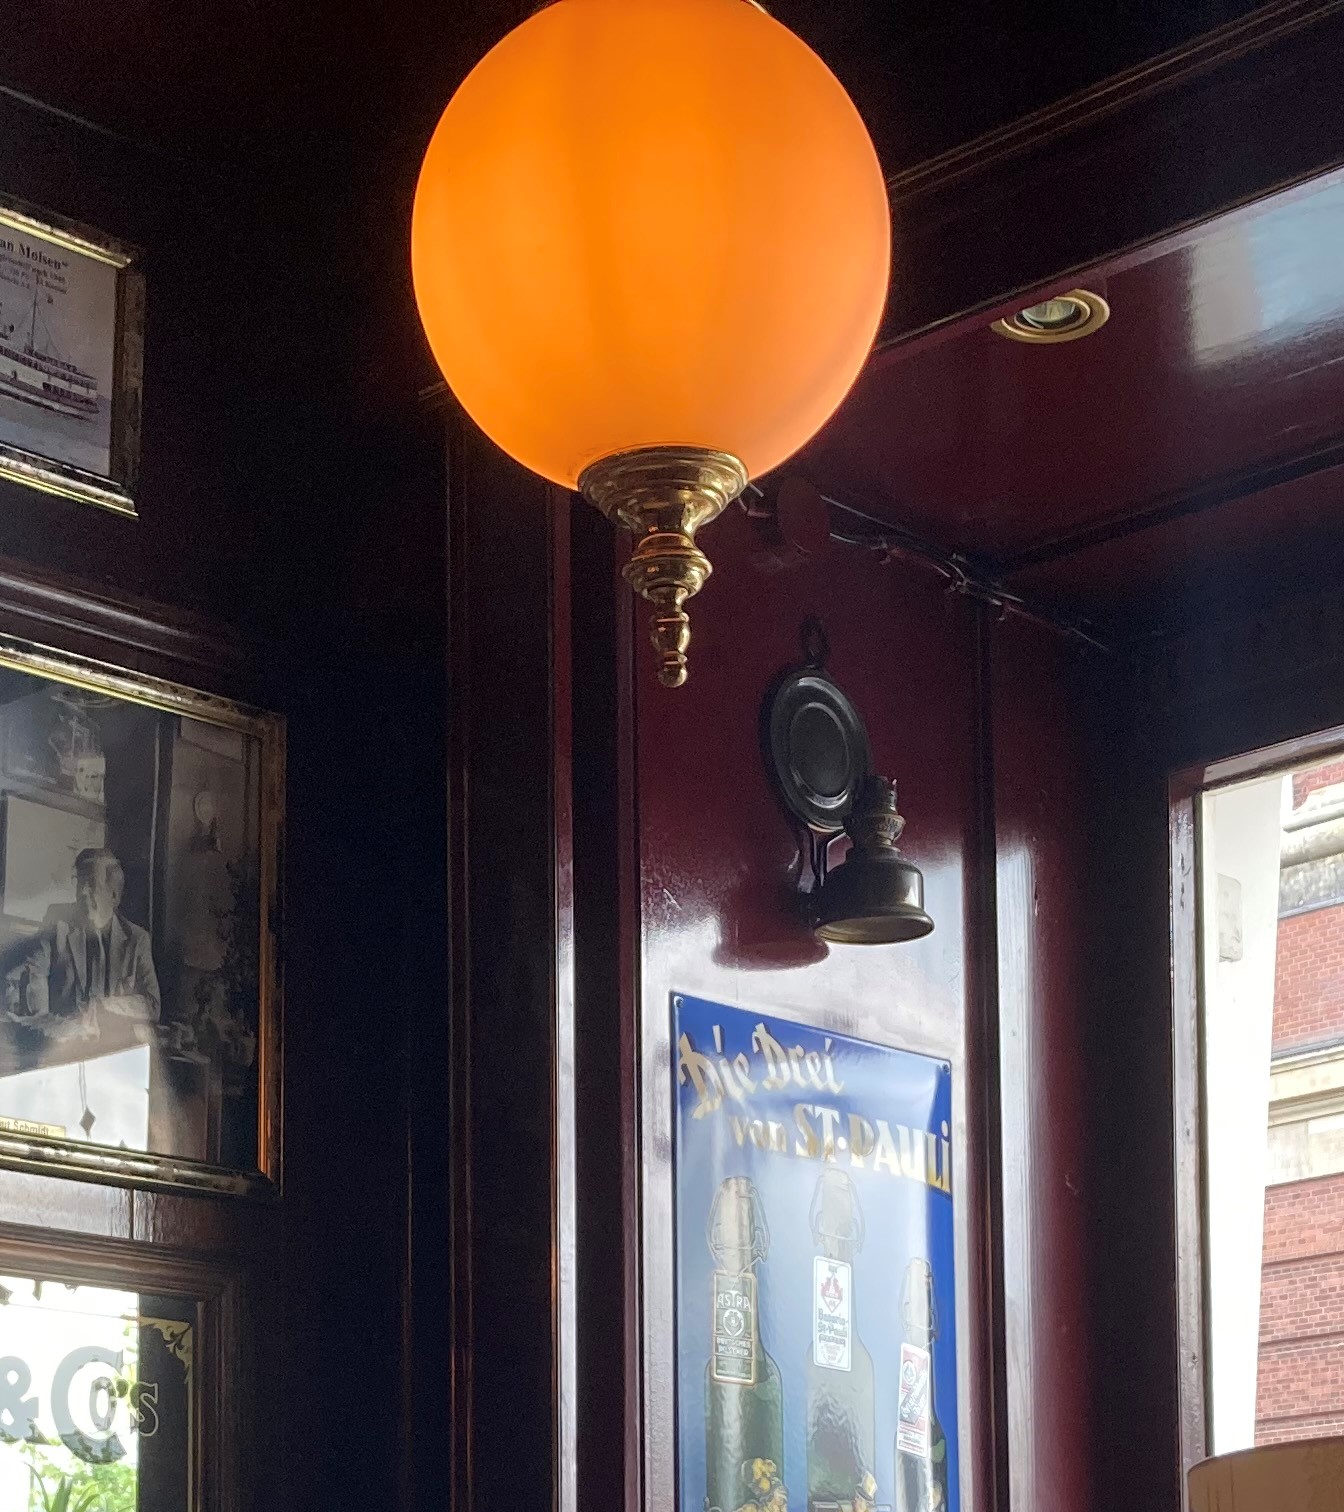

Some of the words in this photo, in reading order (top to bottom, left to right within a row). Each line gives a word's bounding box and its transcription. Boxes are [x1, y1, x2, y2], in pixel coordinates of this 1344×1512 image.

[678, 1023, 757, 1121] Die
[751, 1021, 844, 1095] Drei
[13, 1119, 50, 1137] Schmidt
[728, 1112, 788, 1152] von
[717, 1290, 752, 1313] ASTRA
